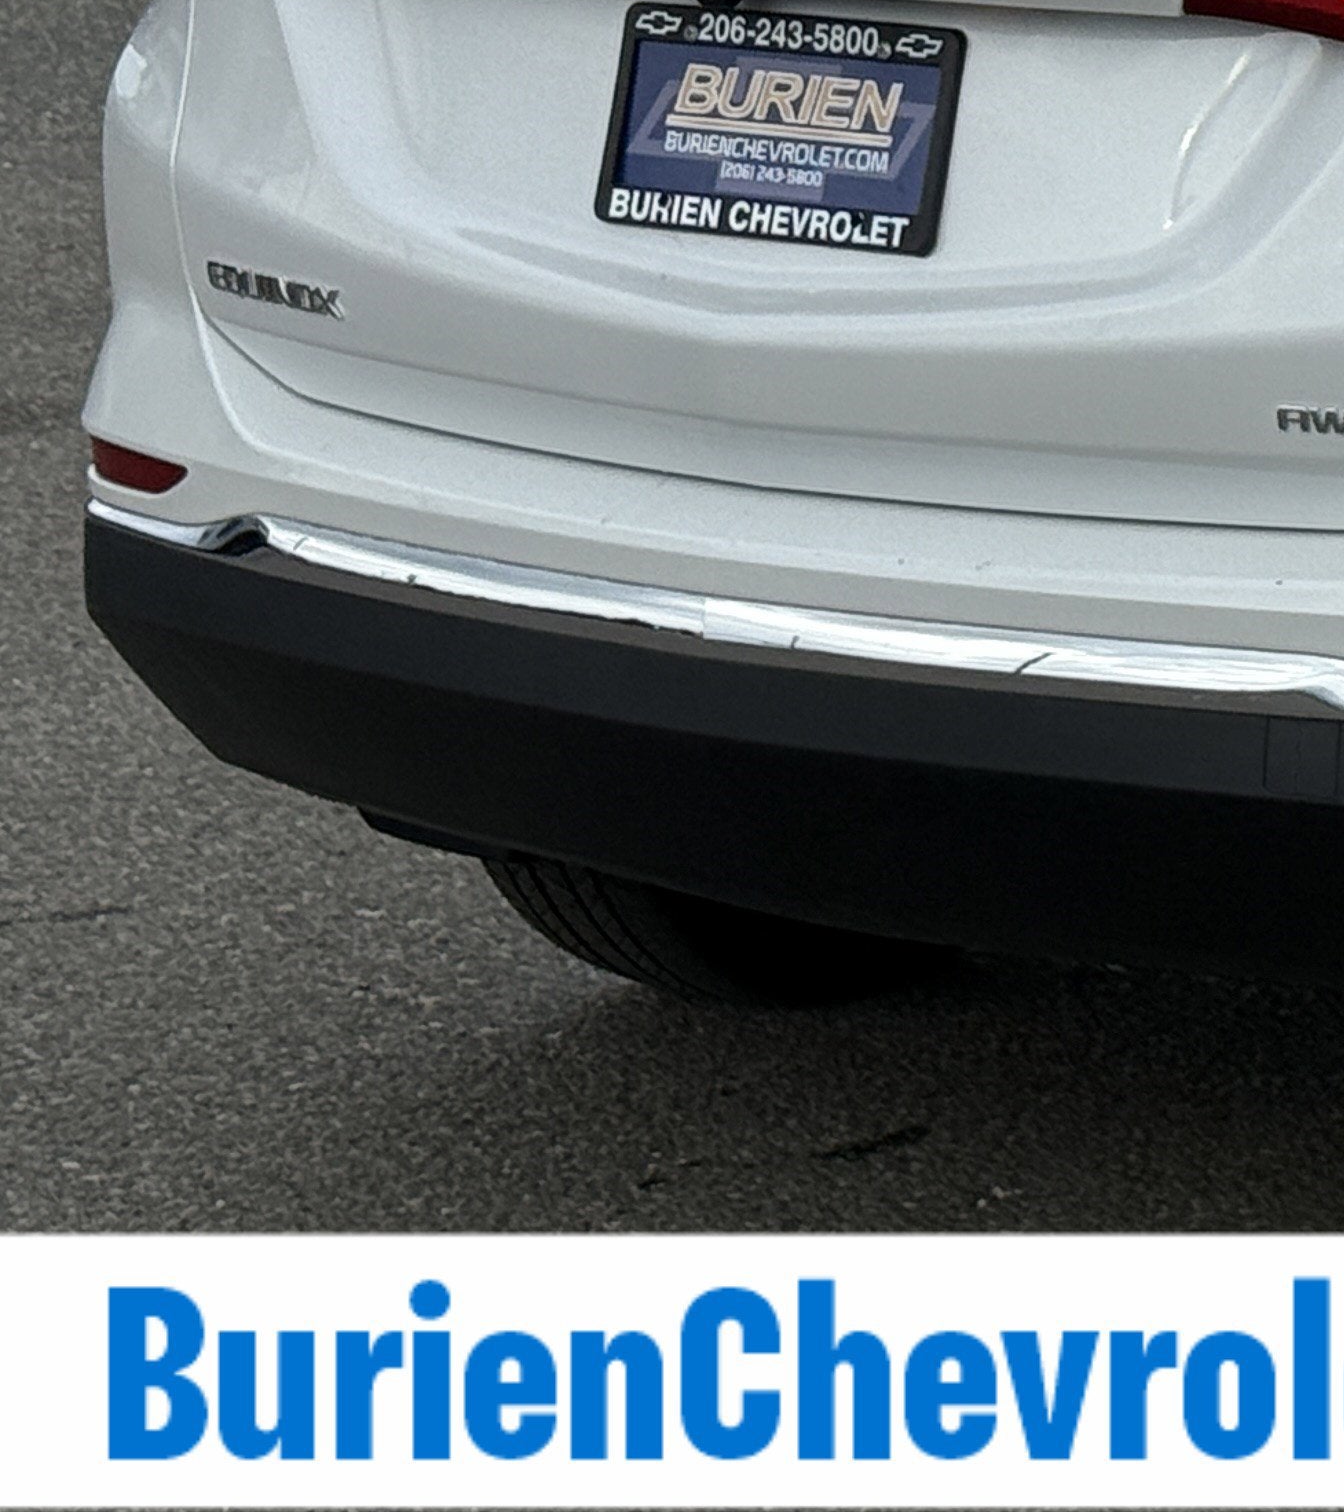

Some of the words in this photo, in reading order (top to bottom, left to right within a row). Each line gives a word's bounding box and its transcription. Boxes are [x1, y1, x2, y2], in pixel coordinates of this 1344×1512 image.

[697, 13, 879, 56] 206-243-5800
[674, 63, 904, 133] BURIEN
[664, 130, 890, 173] BURIENCHEVROLET.COM
[756, 164, 822, 187] 243-5800
